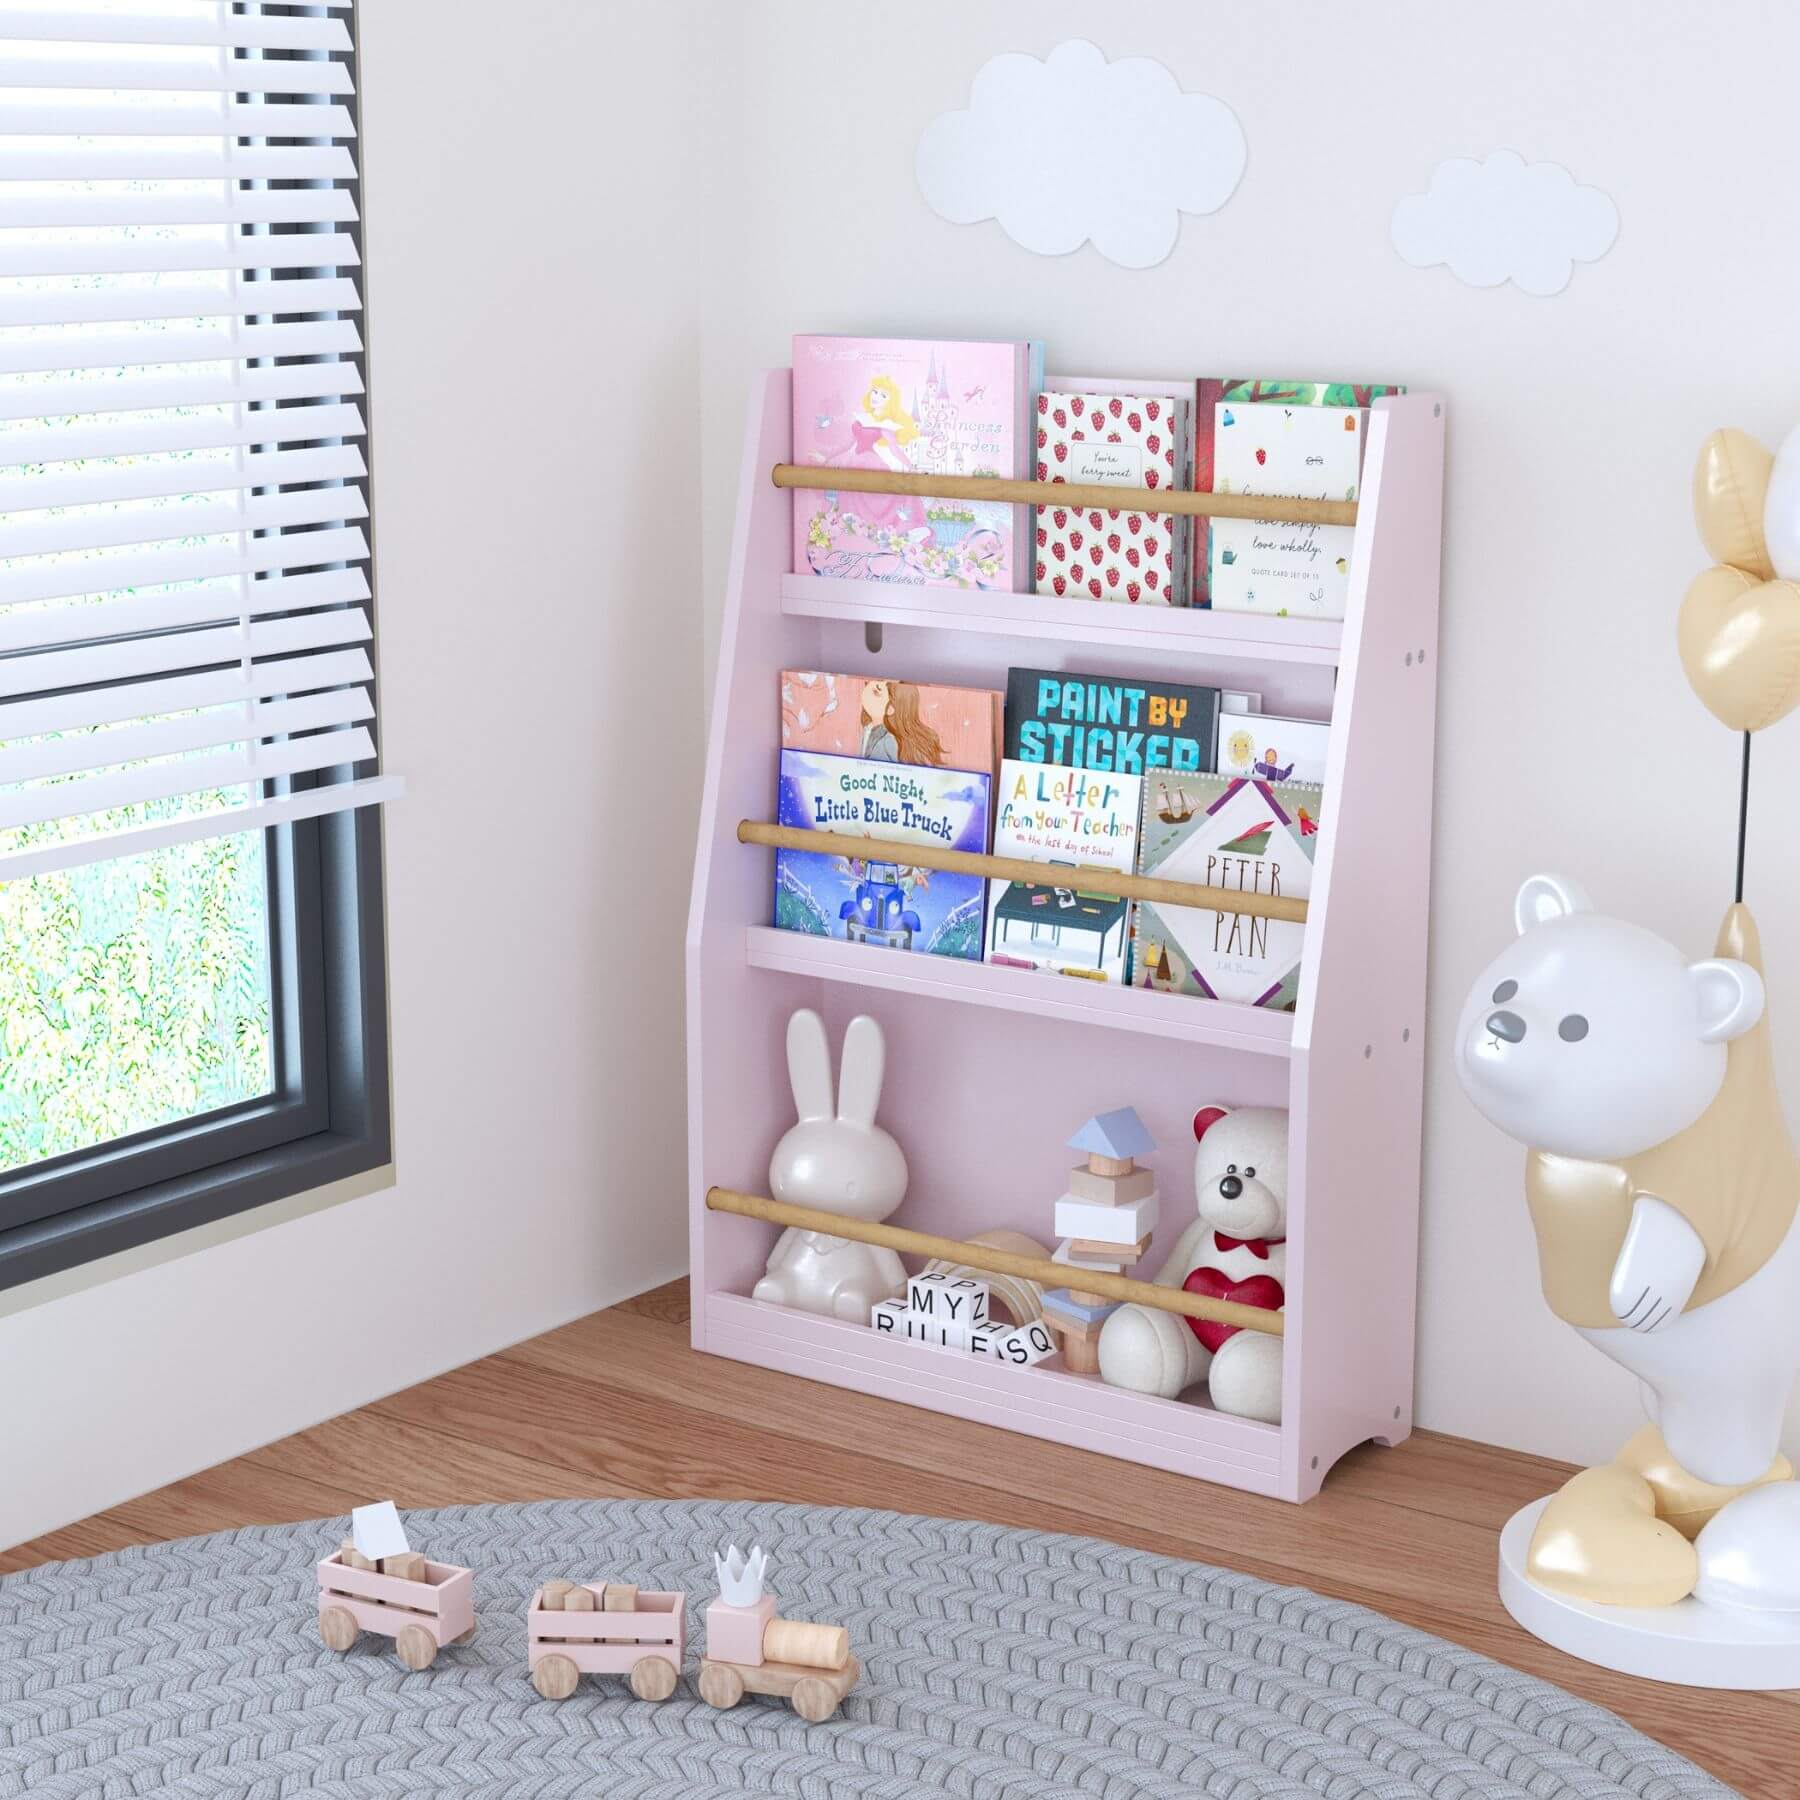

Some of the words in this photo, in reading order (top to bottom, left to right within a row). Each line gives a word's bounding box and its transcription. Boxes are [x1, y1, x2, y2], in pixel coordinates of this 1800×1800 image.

[927, 435, 1000, 459] Garden
[1106, 468, 1131, 477] sweet
[1252, 535, 1277, 549] love
[1251, 567, 1270, 576] QUOTE
[1037, 679, 1146, 727] PAINT
[1148, 695, 1188, 729] BY
[840, 773, 877, 792] Good
[882, 774, 928, 806] Night,
[1013, 774, 1028, 801] A
[1036, 771, 1120, 809] Letter
[814, 796, 859, 823] Little
[863, 797, 899, 824] Blue
[901, 802, 953, 841] Truck
[1001, 803, 1033, 829] from
[1035, 810, 1068, 830] your
[1070, 811, 1134, 837] Teacher
[1028, 836, 1041, 845] the
[1044, 837, 1061, 849] last
[1065, 840, 1078, 854] day
[1080, 846, 1090, 856] of
[1213, 911, 1268, 959] PAN
